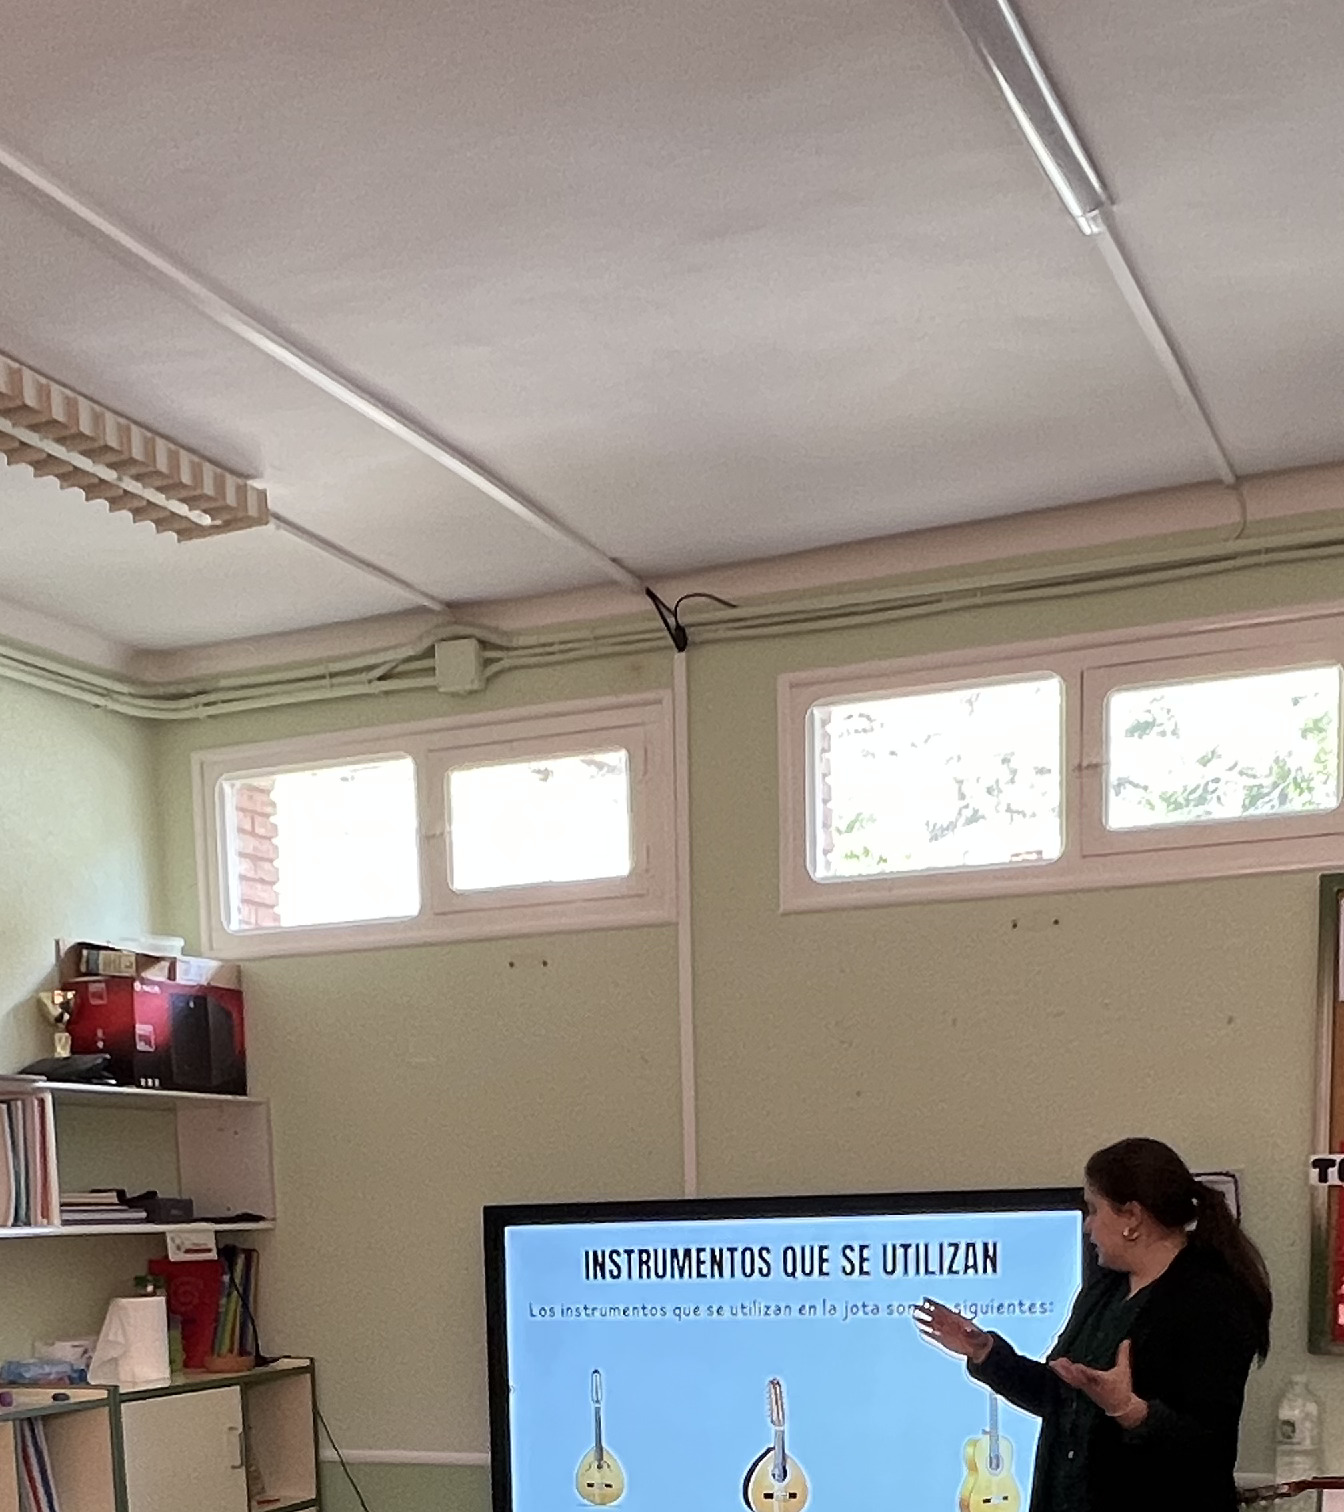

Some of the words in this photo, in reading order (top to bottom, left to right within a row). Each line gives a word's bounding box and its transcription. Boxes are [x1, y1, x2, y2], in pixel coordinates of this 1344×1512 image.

[583, 1247, 772, 1281] INSTRUMENTOS
[782, 1244, 830, 1279] QUE
[841, 1243, 871, 1277] SE
[882, 1241, 998, 1276] UTILIZAN
[528, 1301, 556, 1318] Los
[560, 1302, 667, 1318] instrumentos
[672, 1303, 702, 1321] que
[706, 1304, 725, 1317] se
[730, 1299, 792, 1317] utilizan
[798, 1303, 818, 1316] en
[822, 1298, 838, 1316] la
[843, 1299, 880, 1321] jota
